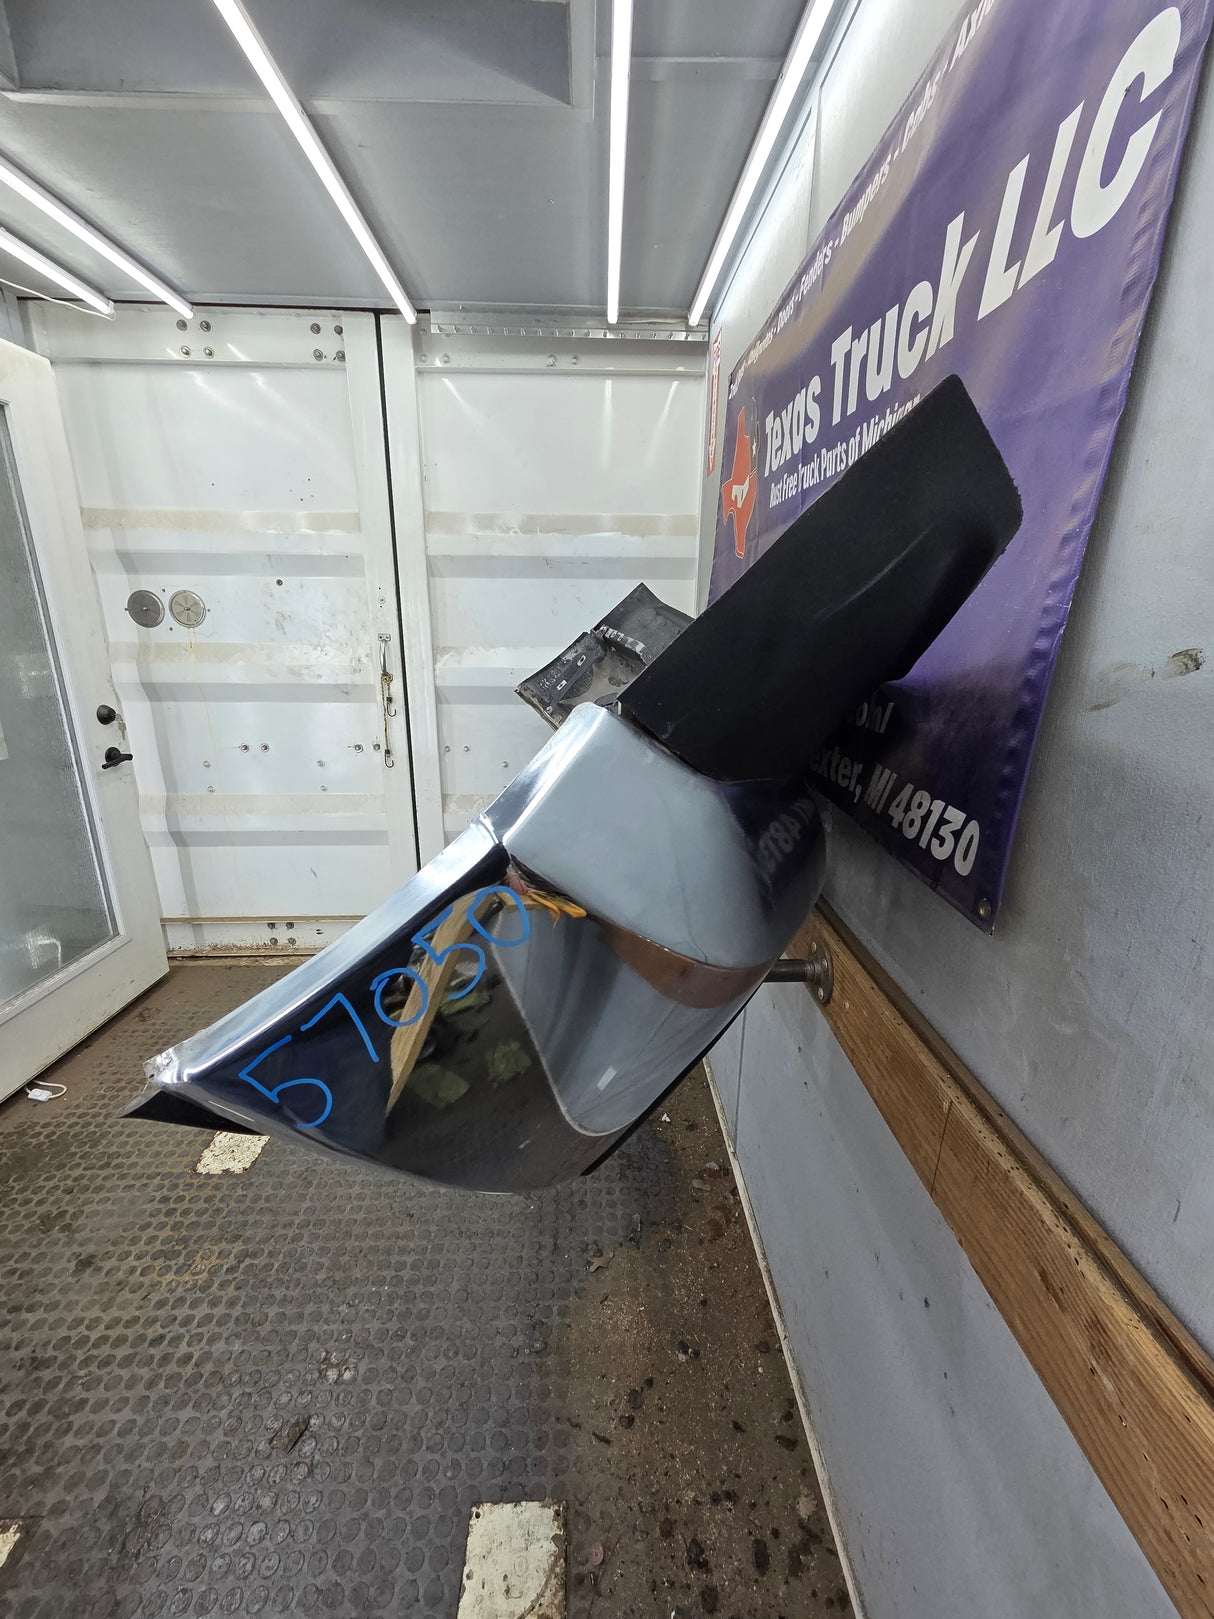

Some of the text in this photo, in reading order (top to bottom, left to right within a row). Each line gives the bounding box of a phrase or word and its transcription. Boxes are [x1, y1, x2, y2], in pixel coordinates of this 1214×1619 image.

[764, 375, 821, 477] Texas
[831, 210, 980, 427] Truck
[977, 6, 1181, 321] LLC
[799, 240, 833, 301] Fenders
[840, 154, 891, 246] Bumpers
[769, 480, 783, 508] Rust
[782, 472, 798, 501] Free
[798, 453, 820, 492] Truck
[821, 441, 847, 480] Parts
[848, 425, 861, 468] of
[809, 745, 980, 877] exter, MI 48130
[239, 886, 531, 1129] 57050
